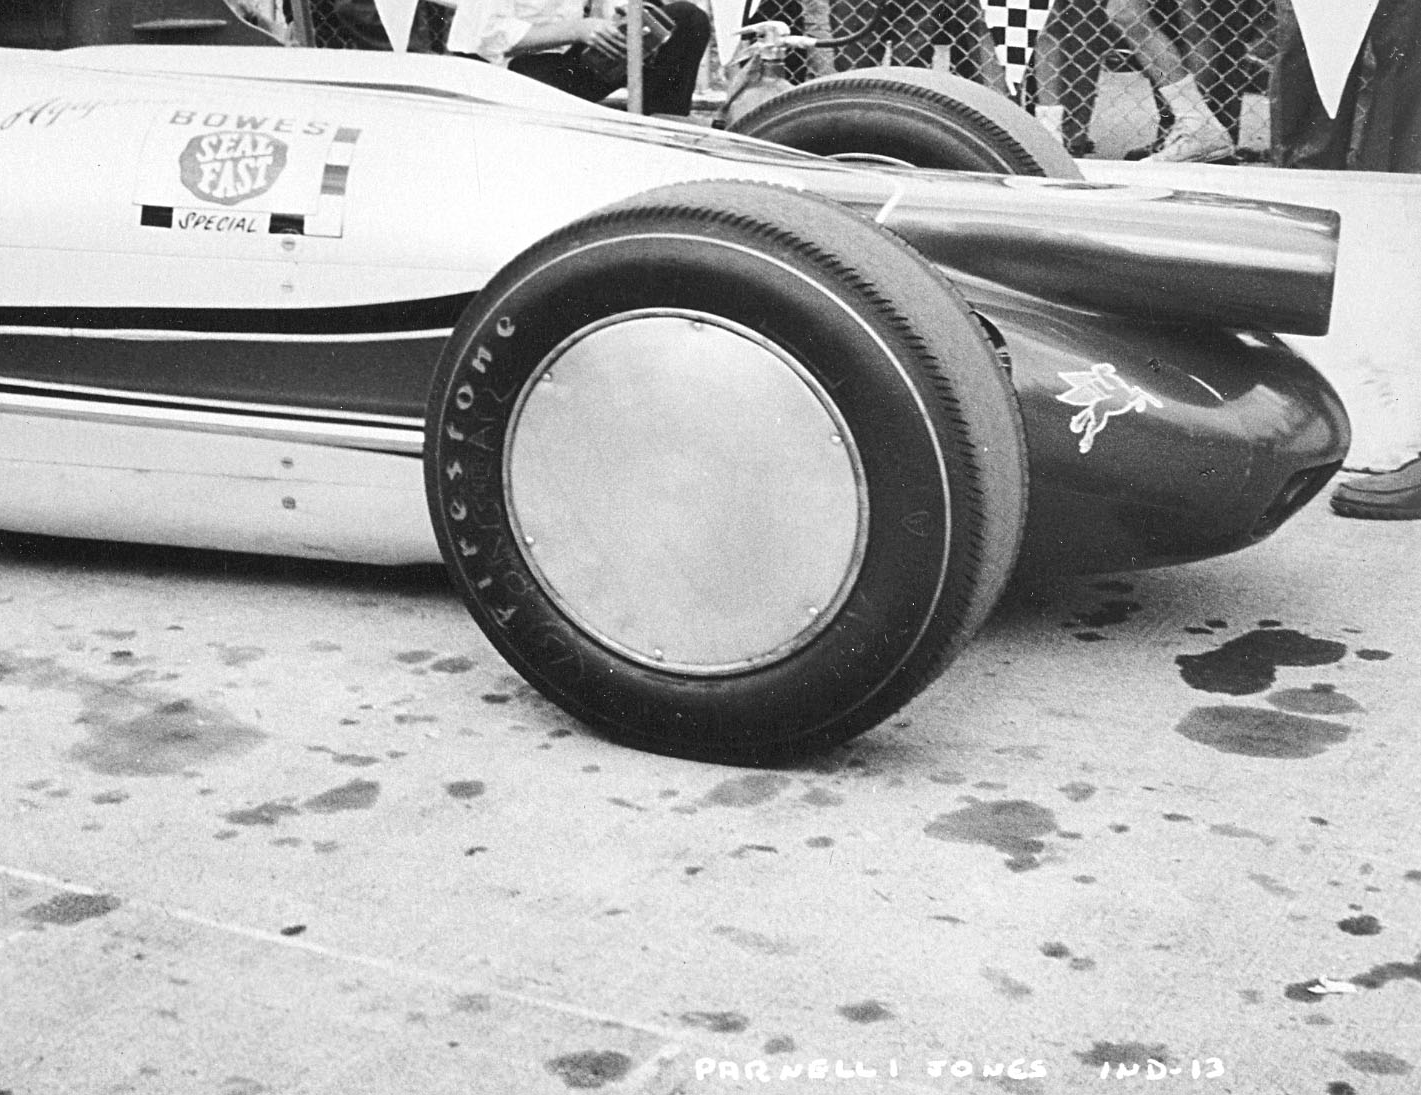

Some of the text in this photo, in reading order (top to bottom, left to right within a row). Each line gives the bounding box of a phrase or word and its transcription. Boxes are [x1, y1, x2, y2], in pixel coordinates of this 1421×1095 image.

[169, 110, 329, 135] BOWES
[195, 131, 275, 163] SEAL
[197, 155, 275, 198] FAST
[179, 212, 258, 233] SPECIAL
[446, 316, 518, 629] Firestone
